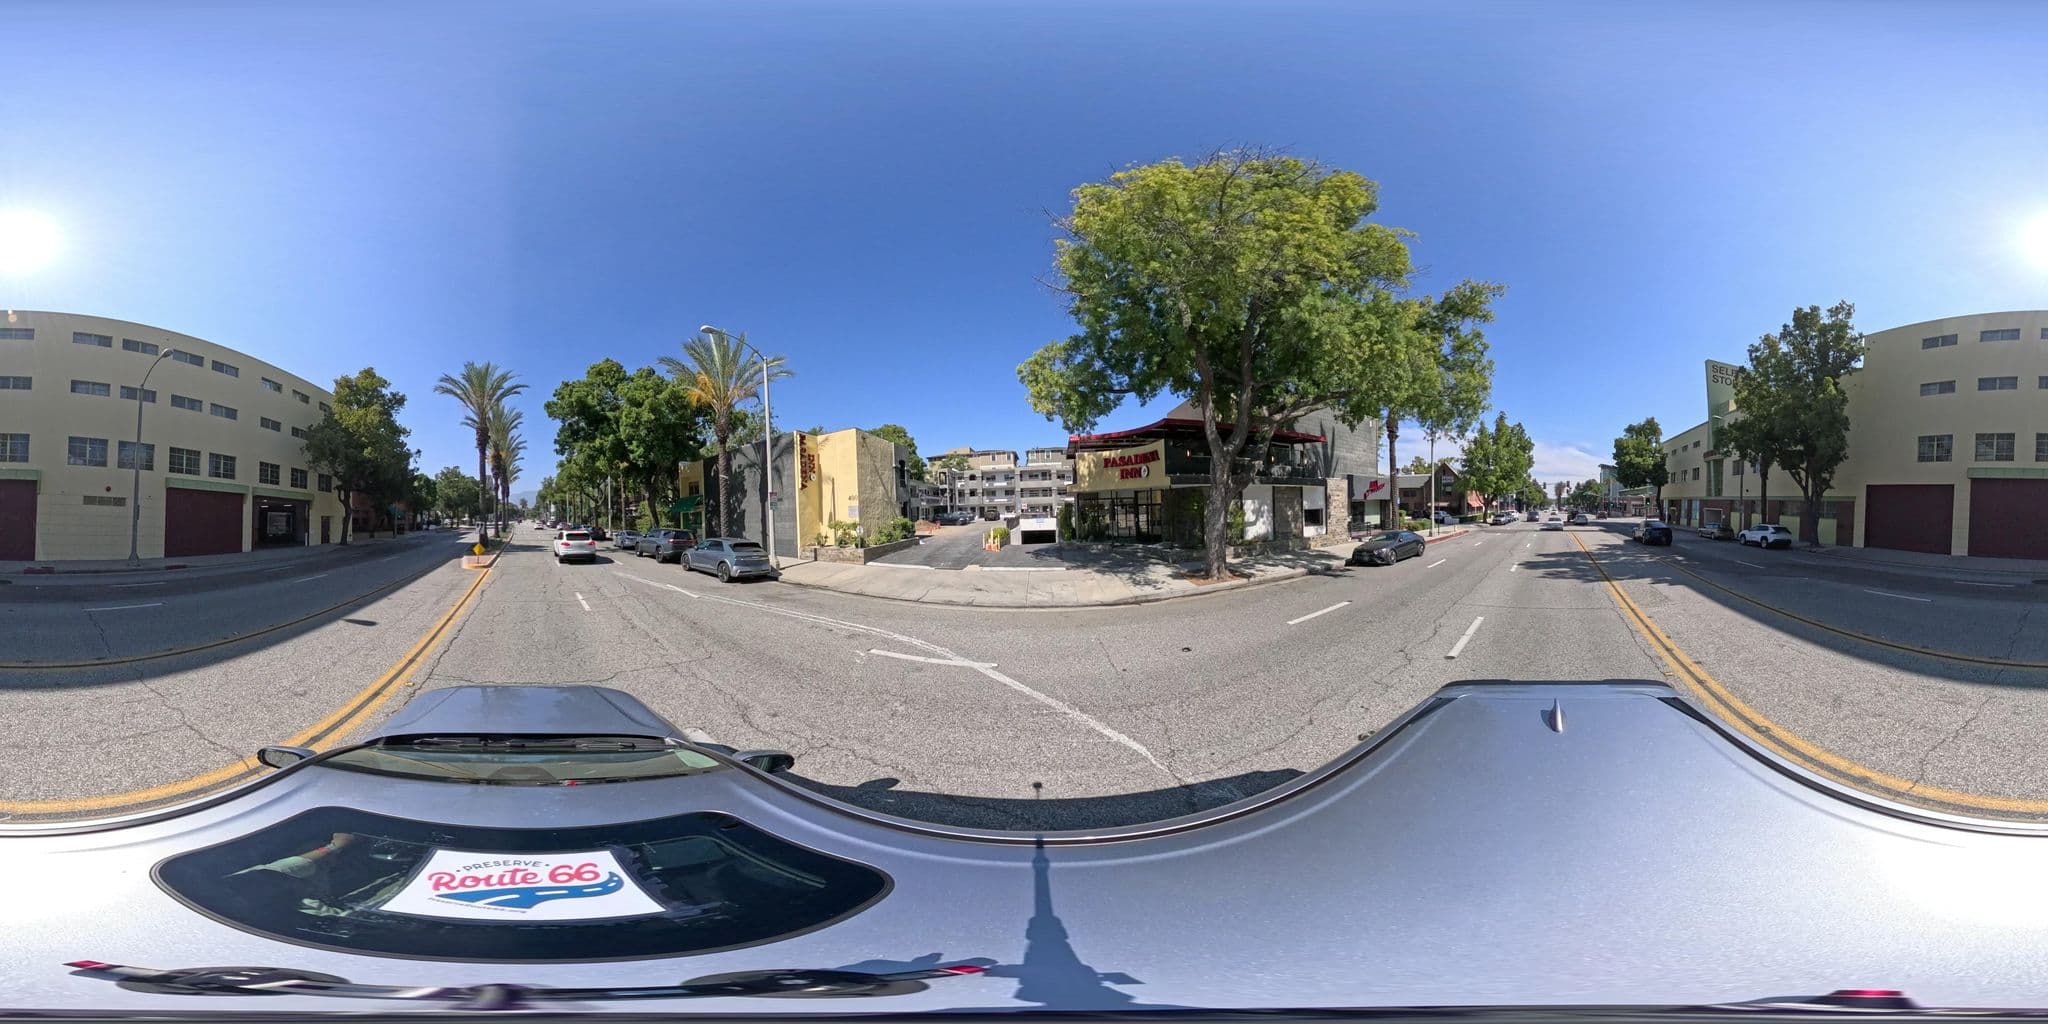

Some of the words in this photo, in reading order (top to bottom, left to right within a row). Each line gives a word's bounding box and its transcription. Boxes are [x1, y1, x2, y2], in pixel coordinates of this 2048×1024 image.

[1120, 466, 1142, 479] INN
[462, 860, 543, 871] PRESERVE
[428, 867, 543, 891] Route
[548, 862, 601, 884] 66
